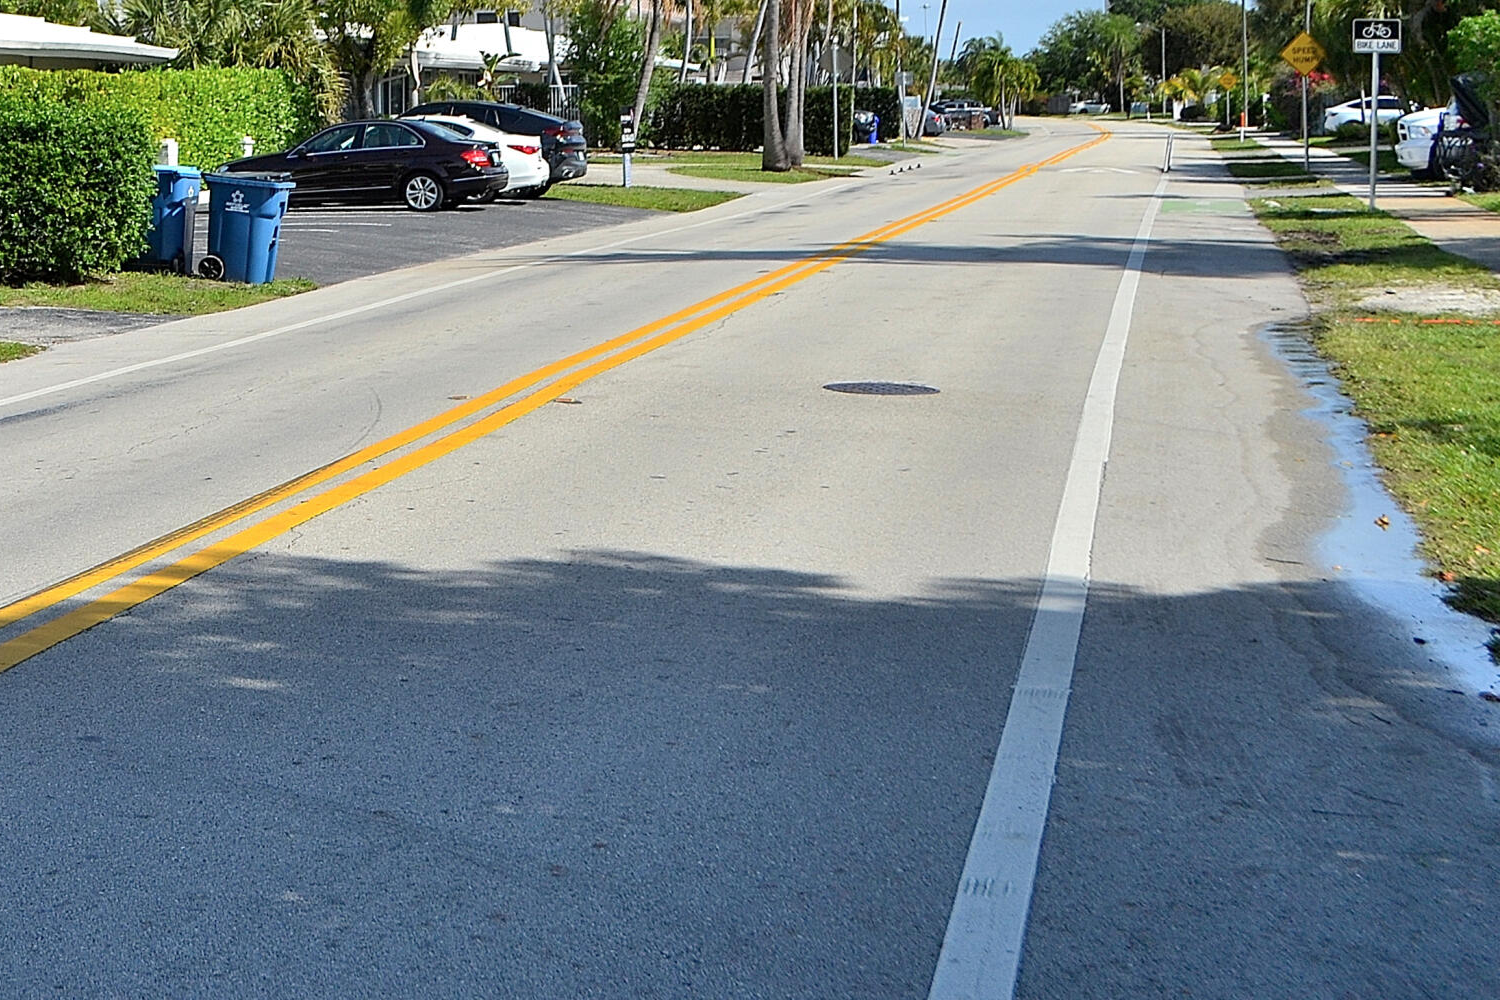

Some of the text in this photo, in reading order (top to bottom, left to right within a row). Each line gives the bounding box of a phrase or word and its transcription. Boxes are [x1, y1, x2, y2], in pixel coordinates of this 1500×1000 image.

[1357, 41, 1397, 49] BIKE LANE
[1292, 47, 1317, 55] SPEED
